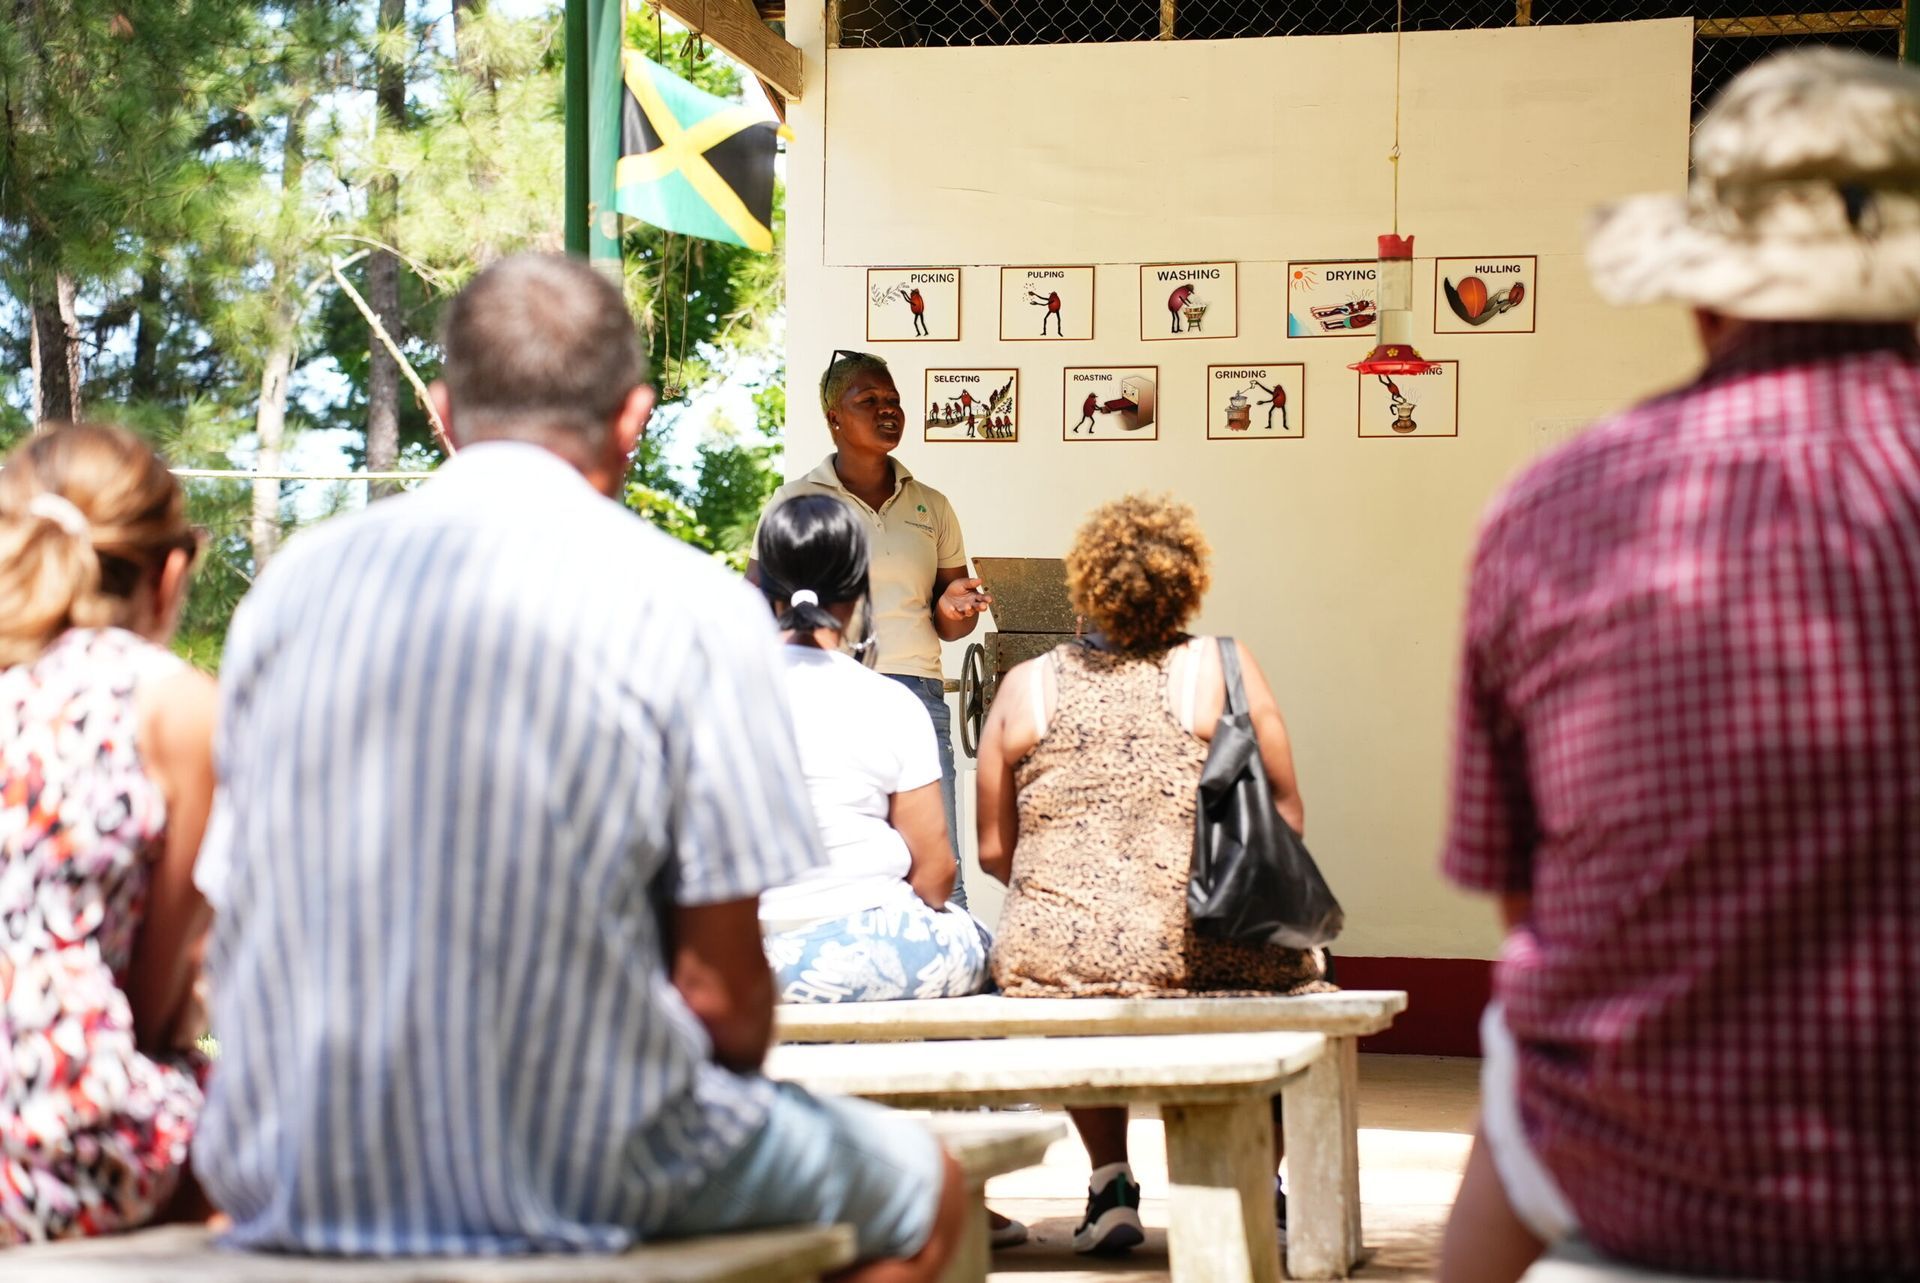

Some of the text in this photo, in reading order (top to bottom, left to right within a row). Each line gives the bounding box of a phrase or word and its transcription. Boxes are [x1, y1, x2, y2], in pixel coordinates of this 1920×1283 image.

[1475, 264, 1521, 274] HULLING
[910, 273, 955, 284] PICKING
[1026, 270, 1065, 279] PULPING
[1157, 269, 1220, 282] WASHING
[1326, 269, 1377, 281] DRYING
[1073, 374, 1113, 383] ROASTING
[1214, 369, 1268, 379] GRINDING
[934, 375, 981, 384] SELECTING
